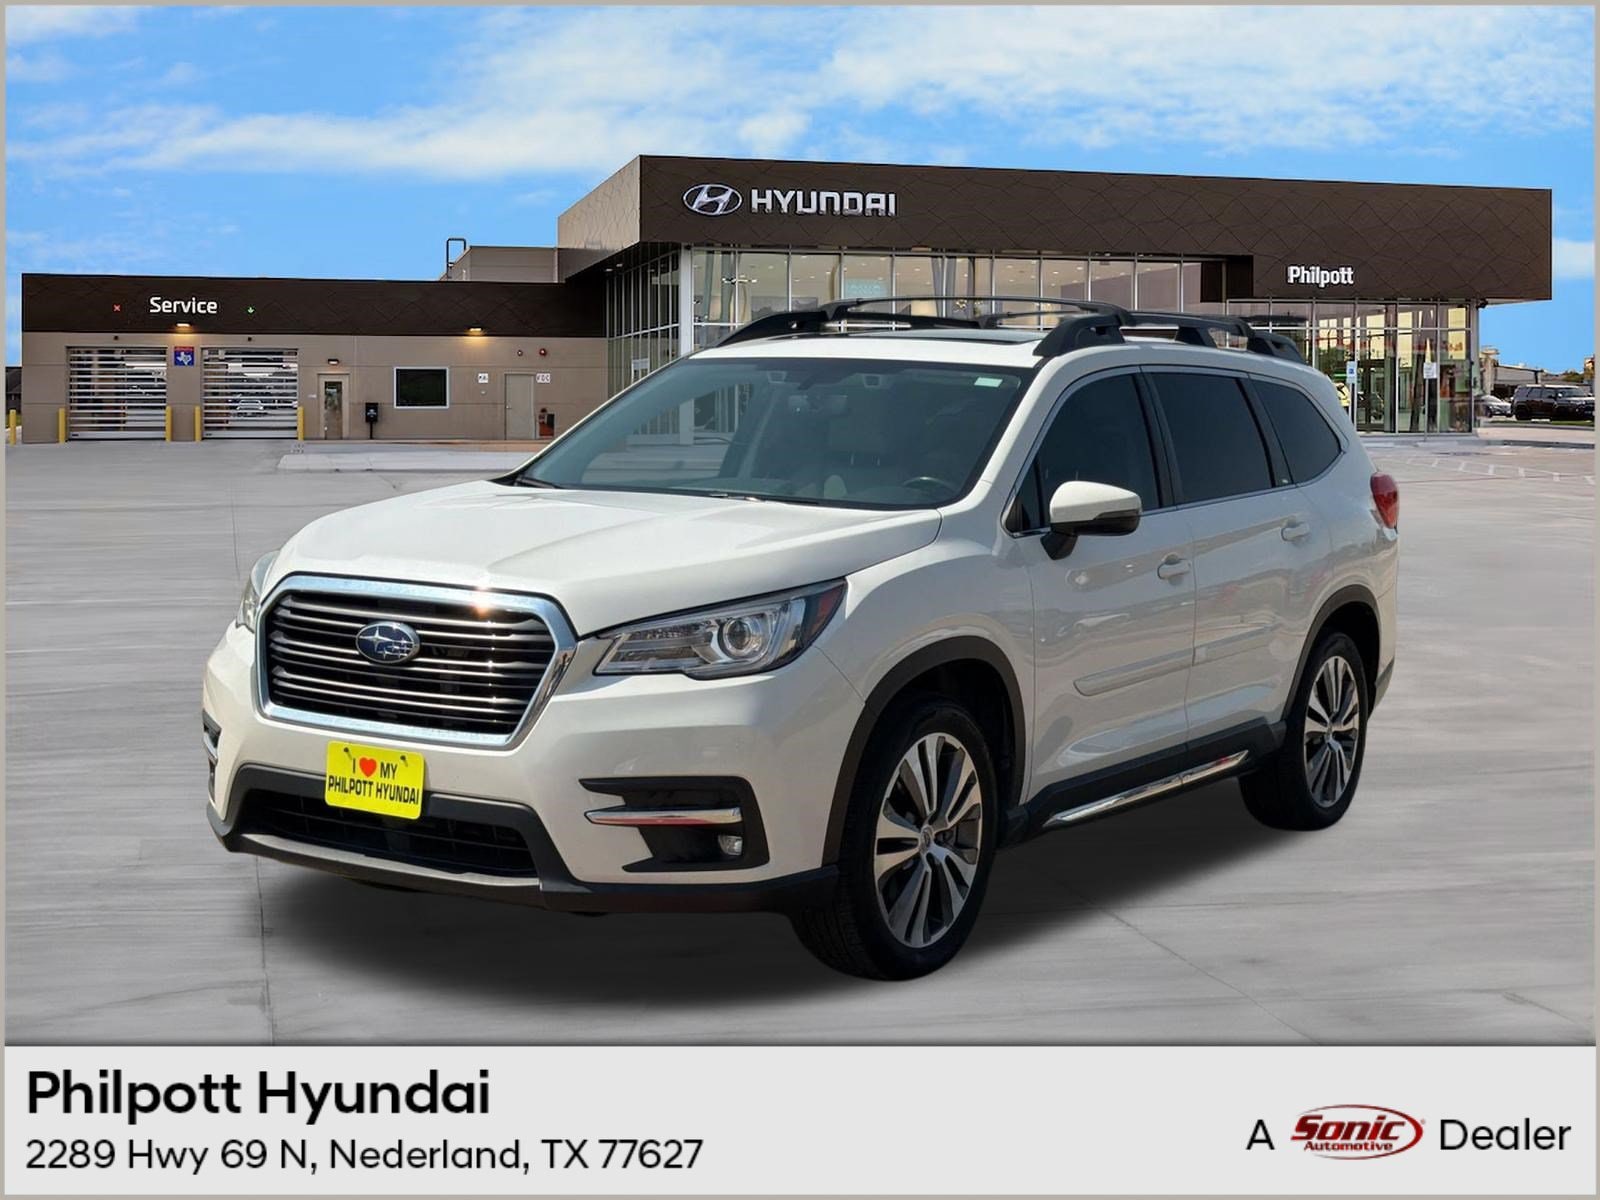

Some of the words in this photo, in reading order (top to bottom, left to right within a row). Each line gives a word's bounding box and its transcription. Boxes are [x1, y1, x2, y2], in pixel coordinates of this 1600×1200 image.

[751, 189, 896, 216] HYUNDAI
[1287, 266, 1354, 288] Philpott
[150, 297, 218, 314] Service
[380, 762, 398, 780] MY
[328, 775, 373, 797] PHILPOTT
[376, 782, 419, 805] HYUNDAI
